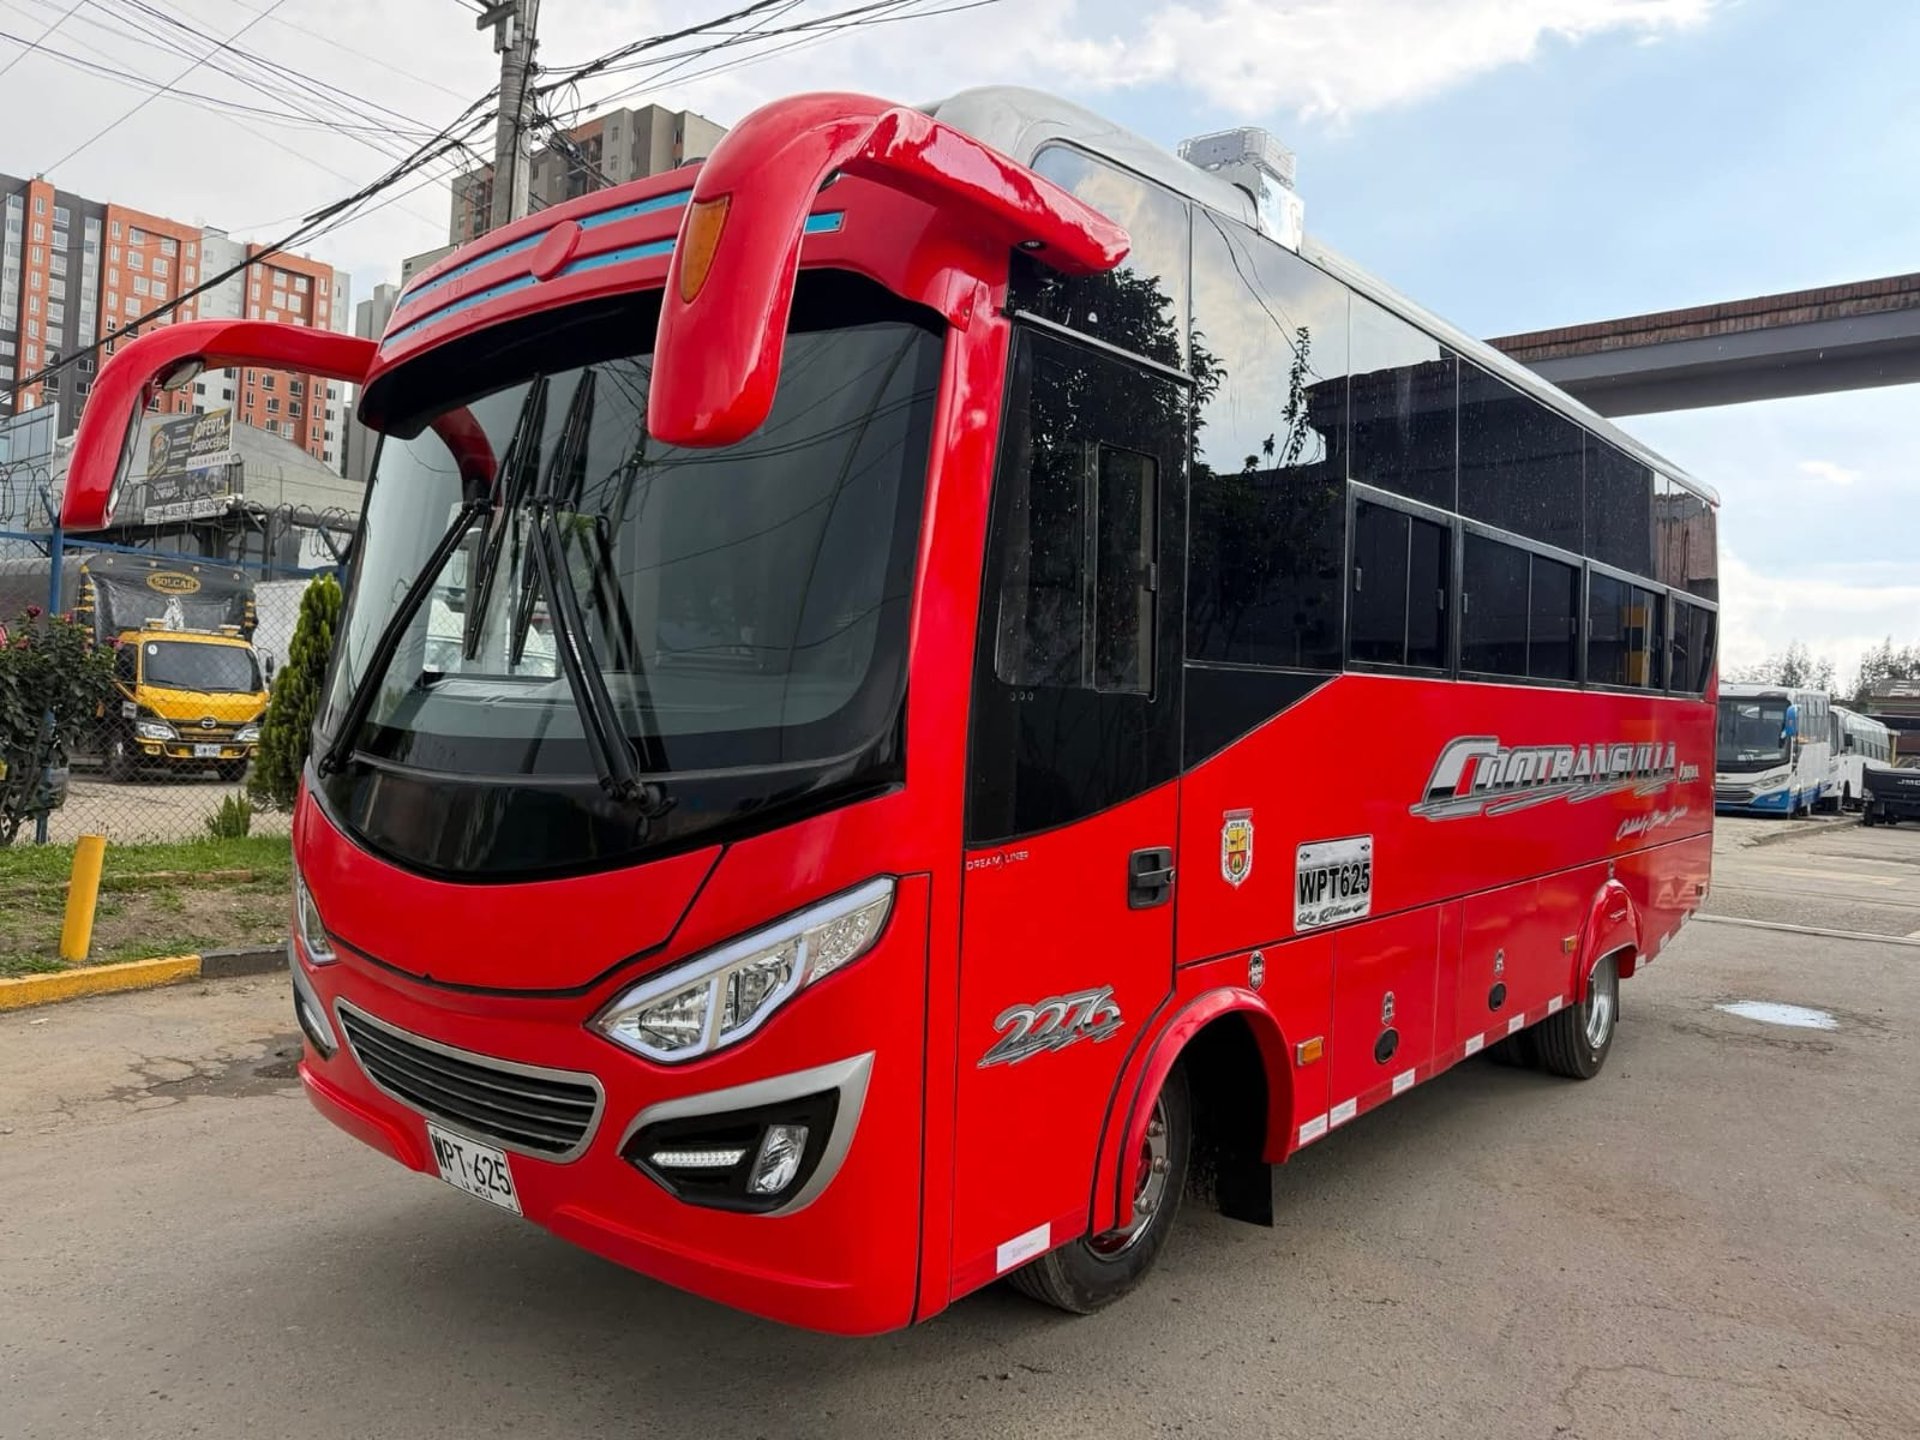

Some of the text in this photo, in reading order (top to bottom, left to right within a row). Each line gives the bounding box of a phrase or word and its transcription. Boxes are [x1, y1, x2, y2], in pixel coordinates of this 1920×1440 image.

[196, 416, 225, 437] OFERTA
[1298, 862, 1371, 905] WPT625
[985, 985, 1122, 1058] 2276
